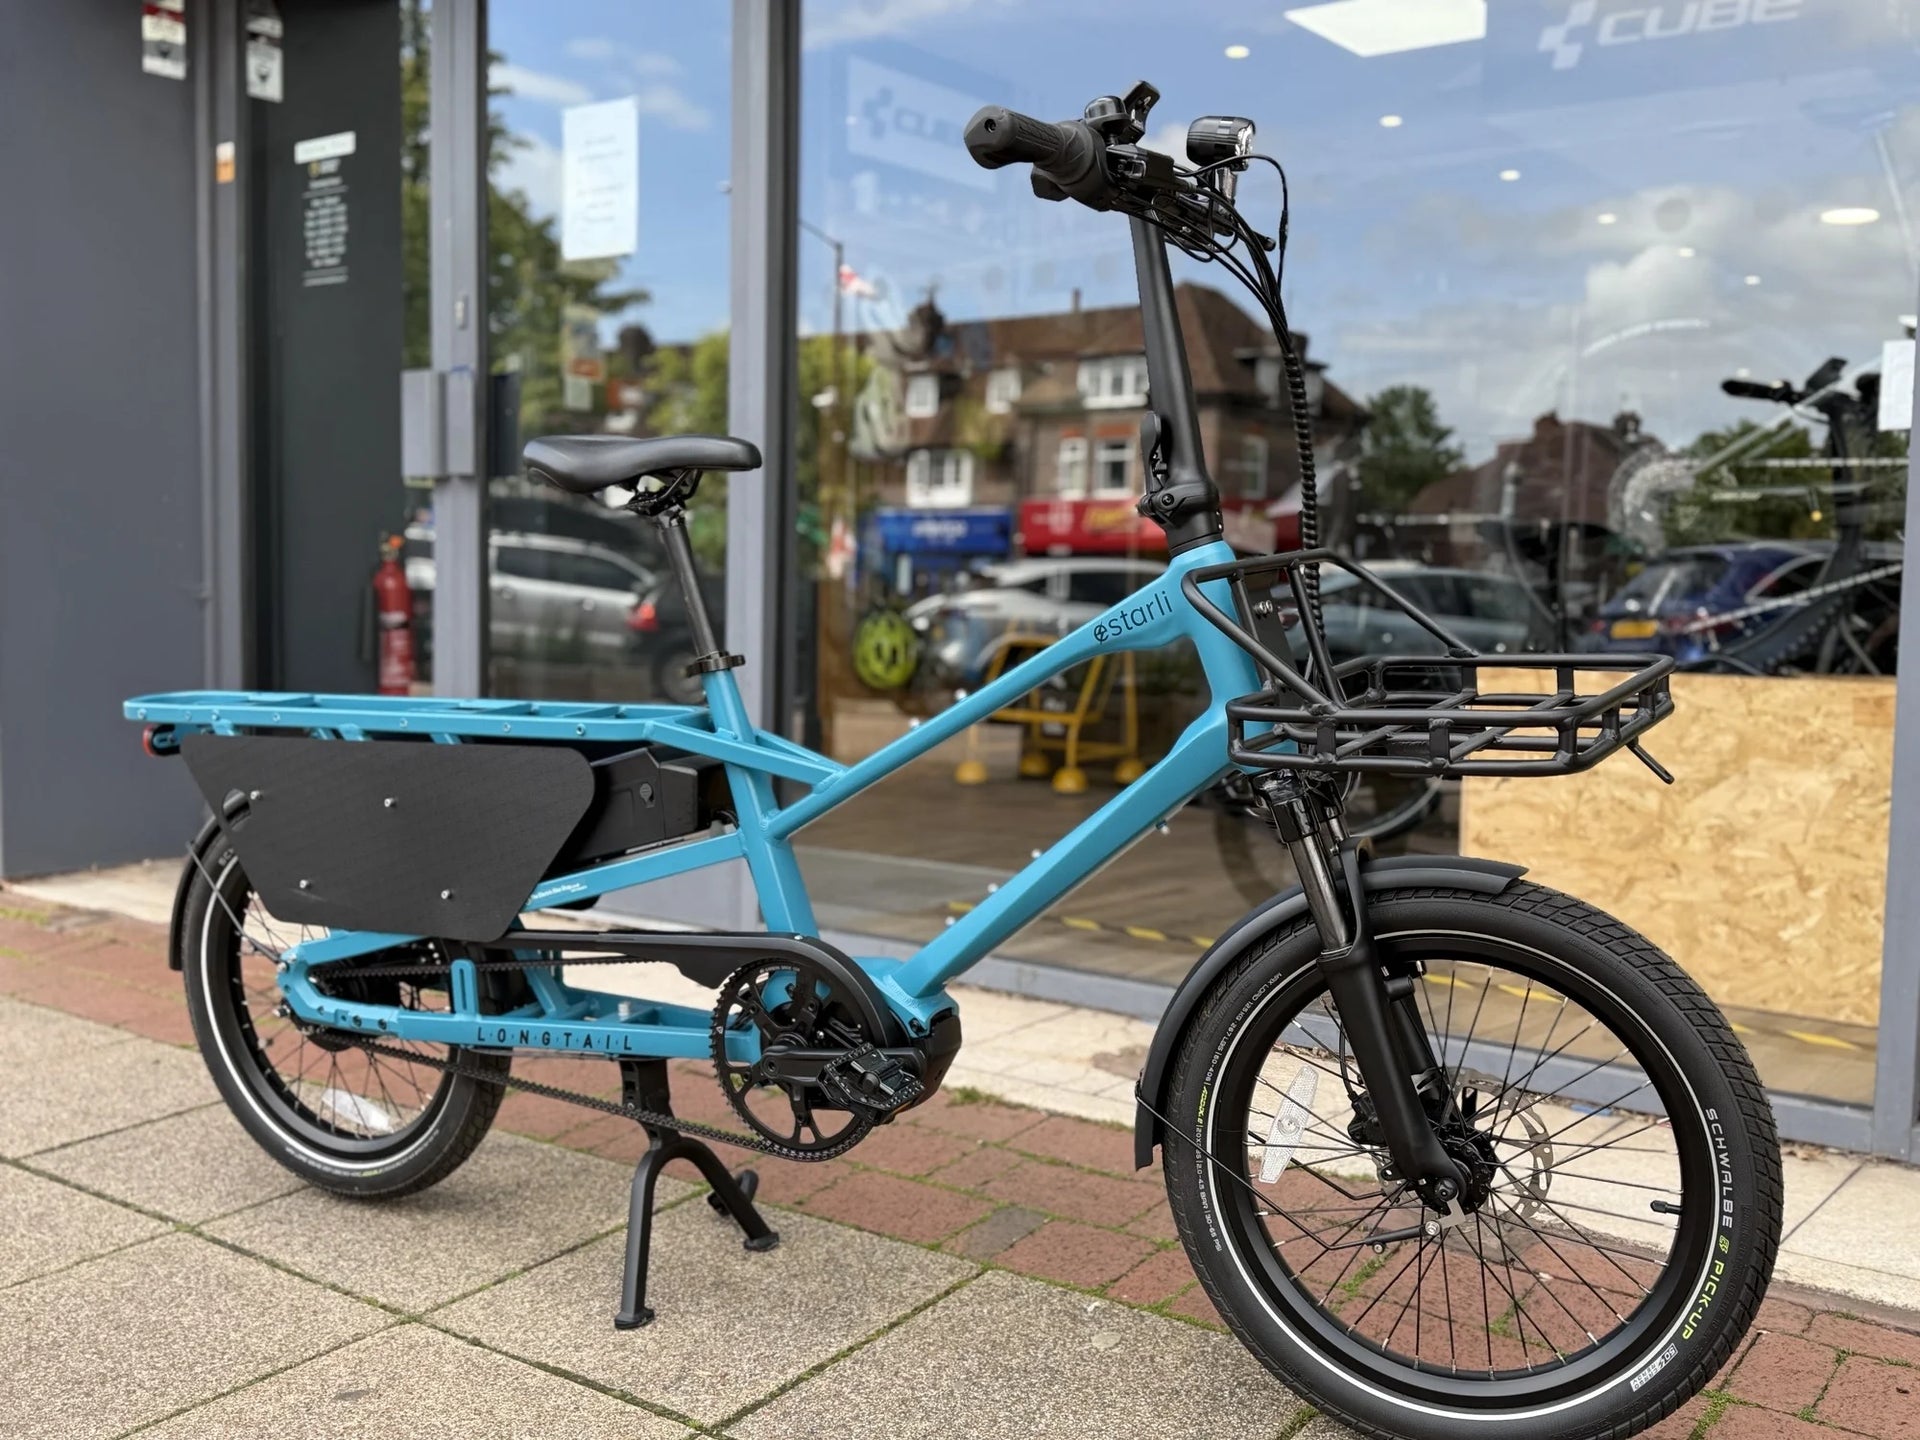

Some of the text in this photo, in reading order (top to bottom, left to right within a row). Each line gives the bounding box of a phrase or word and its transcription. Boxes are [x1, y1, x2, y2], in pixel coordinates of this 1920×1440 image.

[1094, 590, 1173, 645] estarli
[1705, 1107, 1734, 1229] SCHWALBE
[1681, 1259, 1725, 1340] PICK-UP
